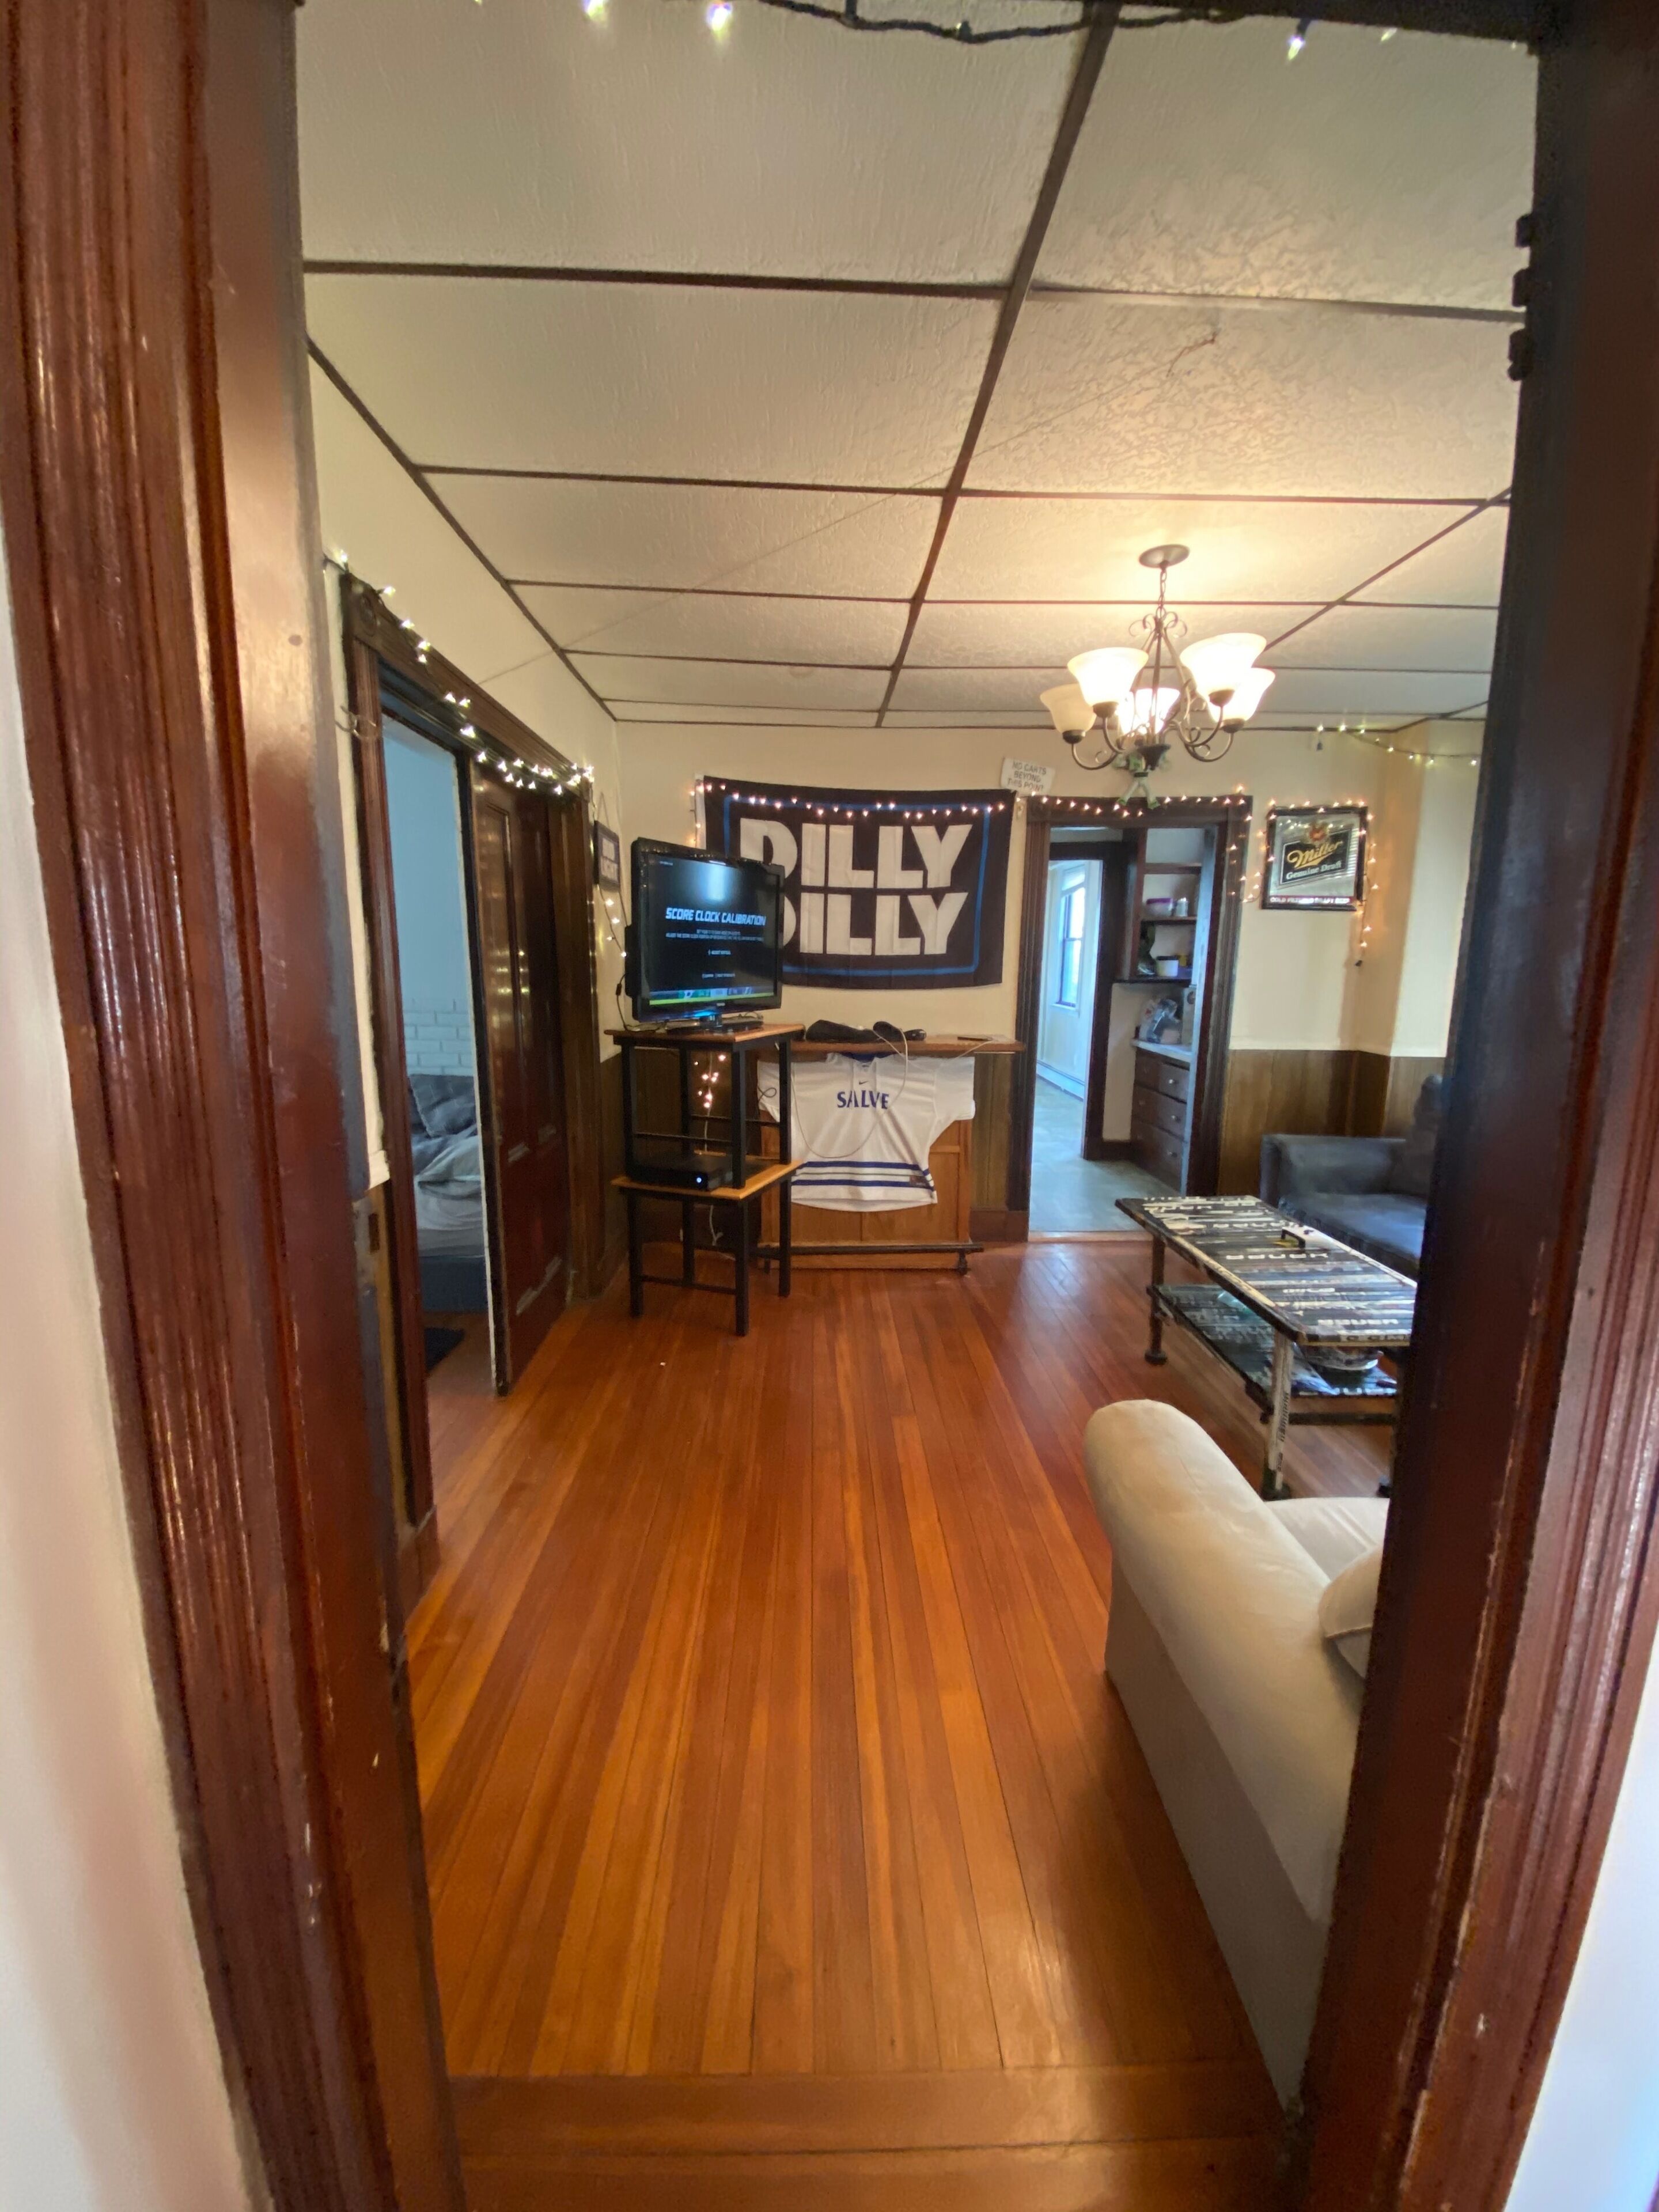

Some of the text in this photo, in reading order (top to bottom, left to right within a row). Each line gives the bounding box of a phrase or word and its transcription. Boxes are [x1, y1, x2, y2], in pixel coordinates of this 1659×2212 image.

[1012, 761, 1047, 775] NO CARTS
[1014, 771, 1041, 783] BEYOND
[740, 817, 973, 888] DILLY
[1287, 841, 1343, 869] Miller
[1286, 860, 1342, 880] Genuine Draft
[666, 907, 767, 926] SCORE CLOCK CALIBRATION
[783, 892, 968, 956] ILLY
[837, 1089, 890, 1109] SALVE
